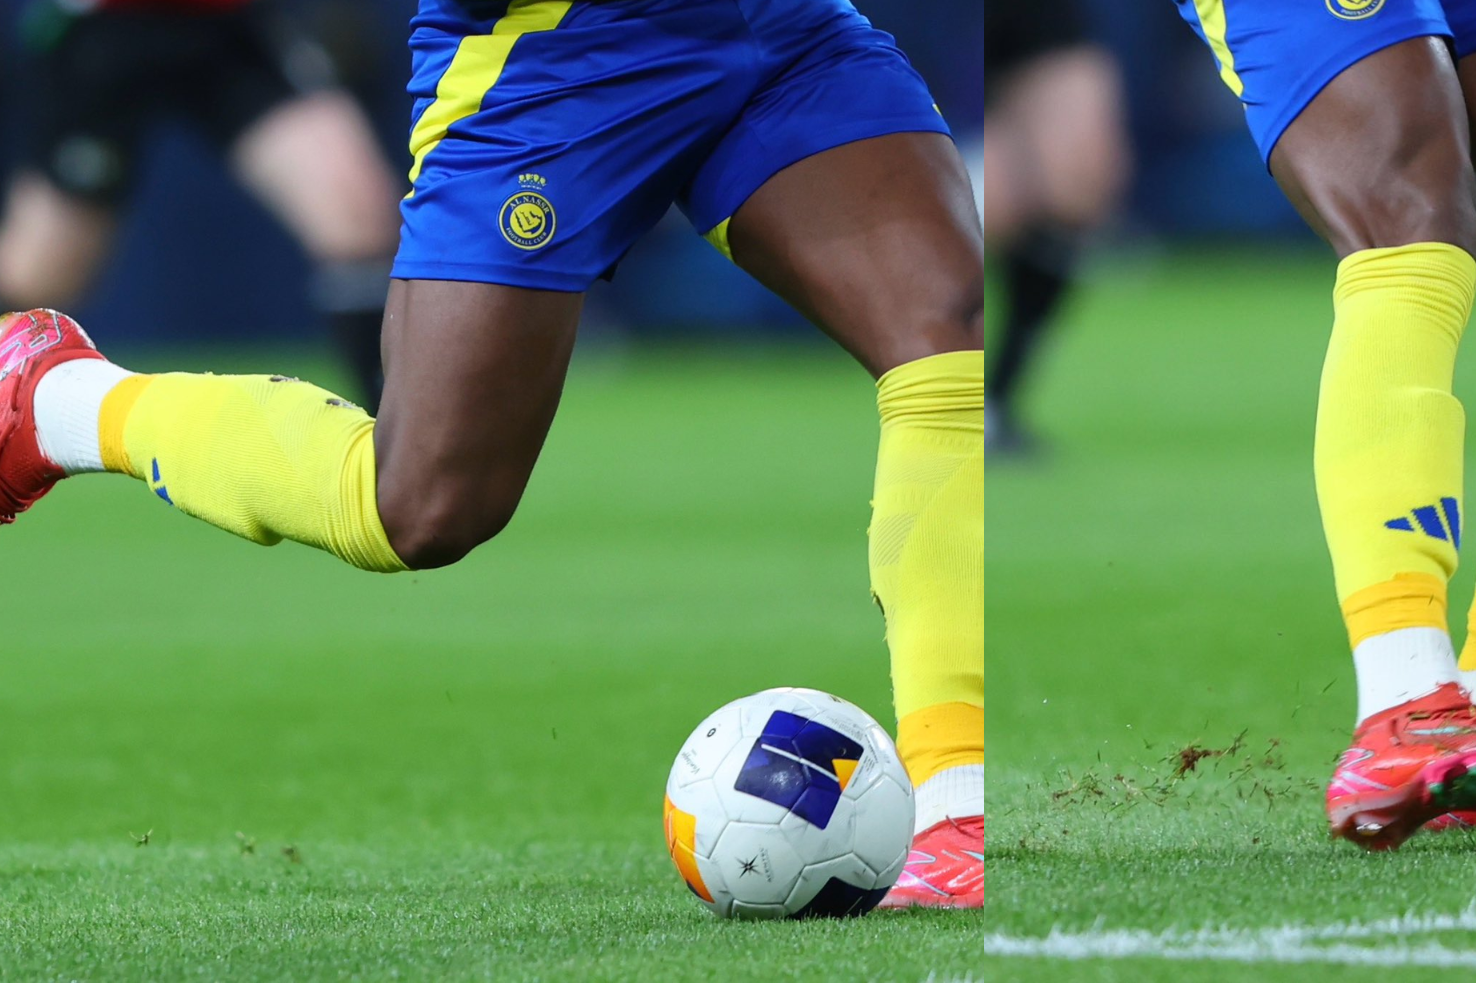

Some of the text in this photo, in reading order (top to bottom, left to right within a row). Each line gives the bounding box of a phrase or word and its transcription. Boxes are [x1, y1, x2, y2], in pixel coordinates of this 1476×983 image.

[522, 195, 550, 214] NASSR
[506, 226, 547, 245] FOOTBALL CLUB
